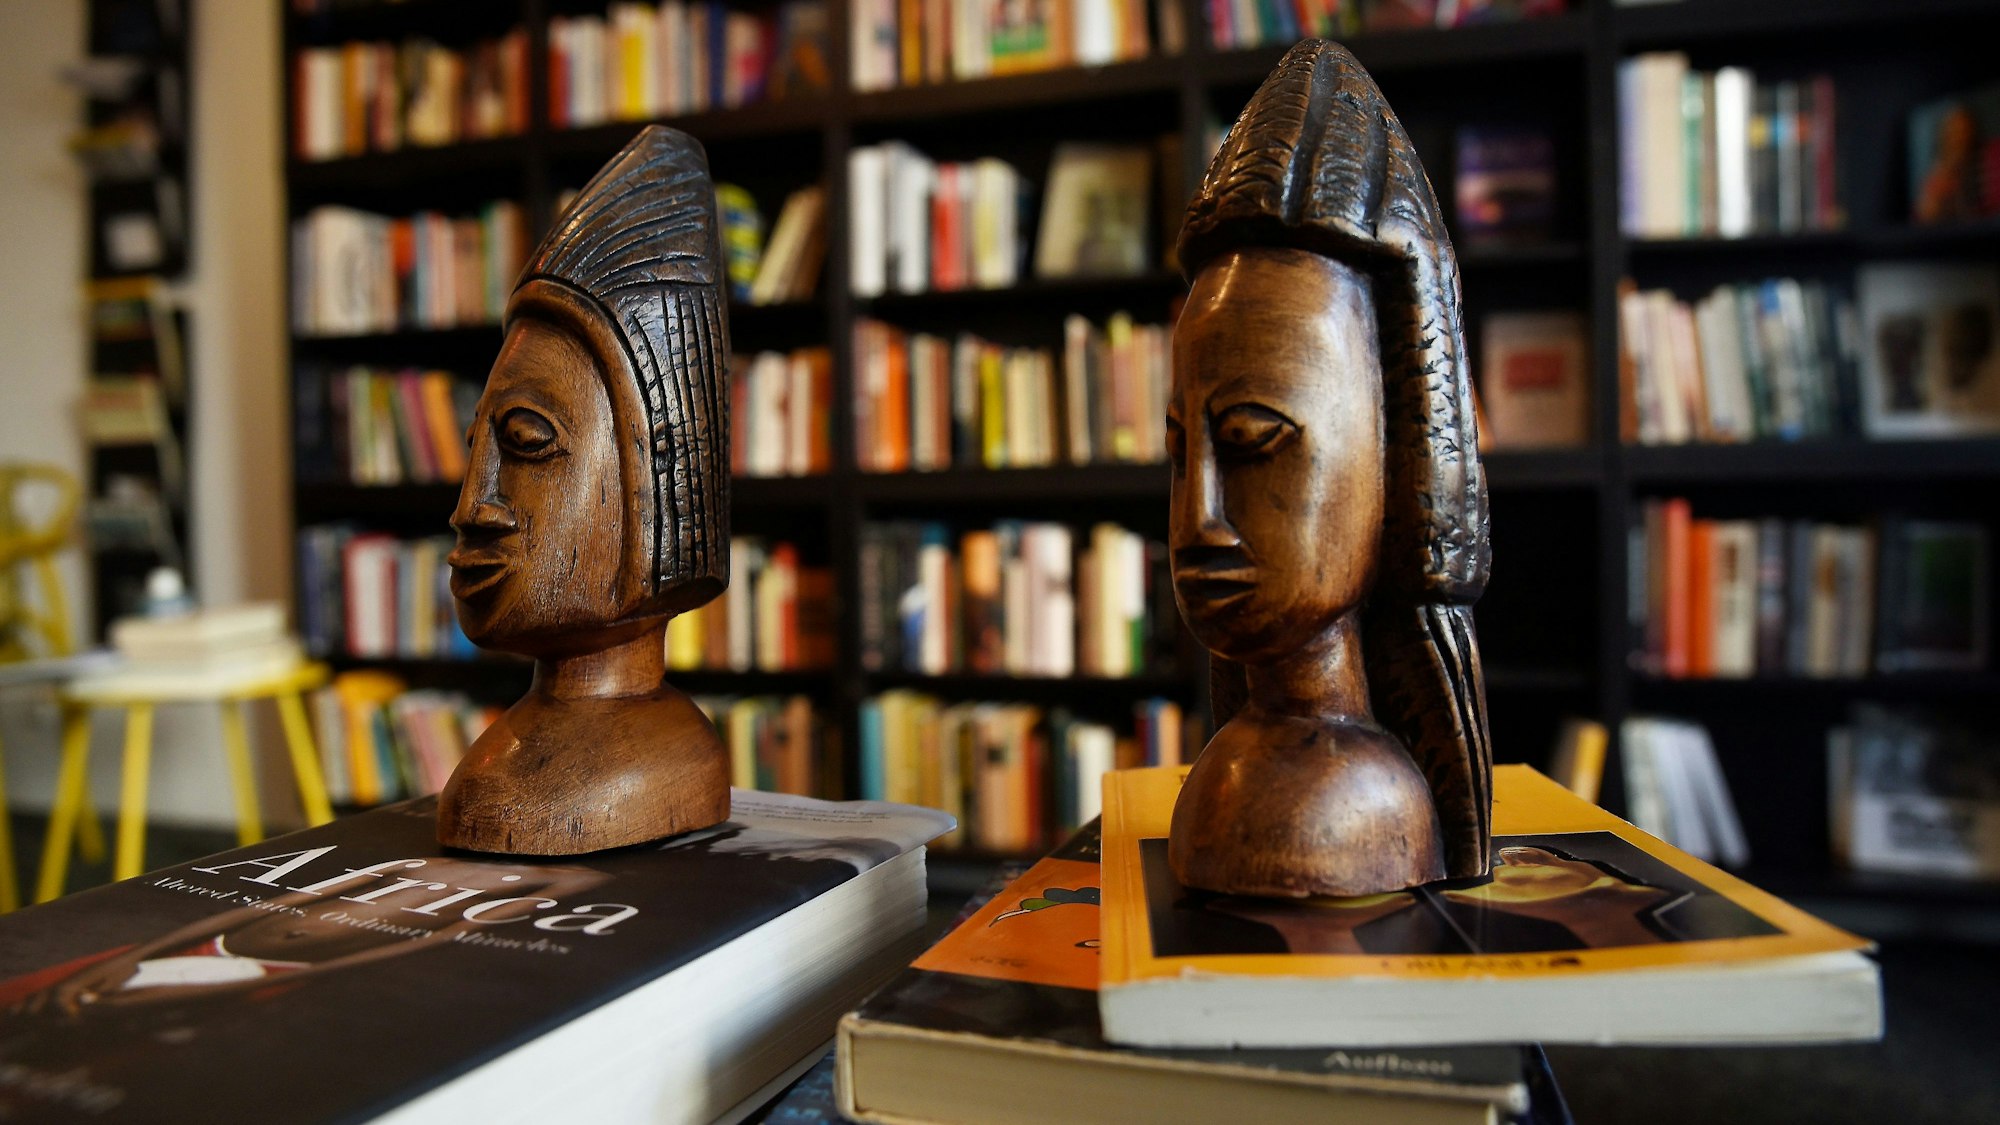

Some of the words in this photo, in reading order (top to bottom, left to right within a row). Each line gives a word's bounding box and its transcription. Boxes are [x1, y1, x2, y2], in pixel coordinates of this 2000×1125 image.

[146, 877, 239, 903] Altered
[319, 911, 433, 941] Ordinary
[444, 930, 572, 956] Miracles
[191, 845, 639, 936] Africa
